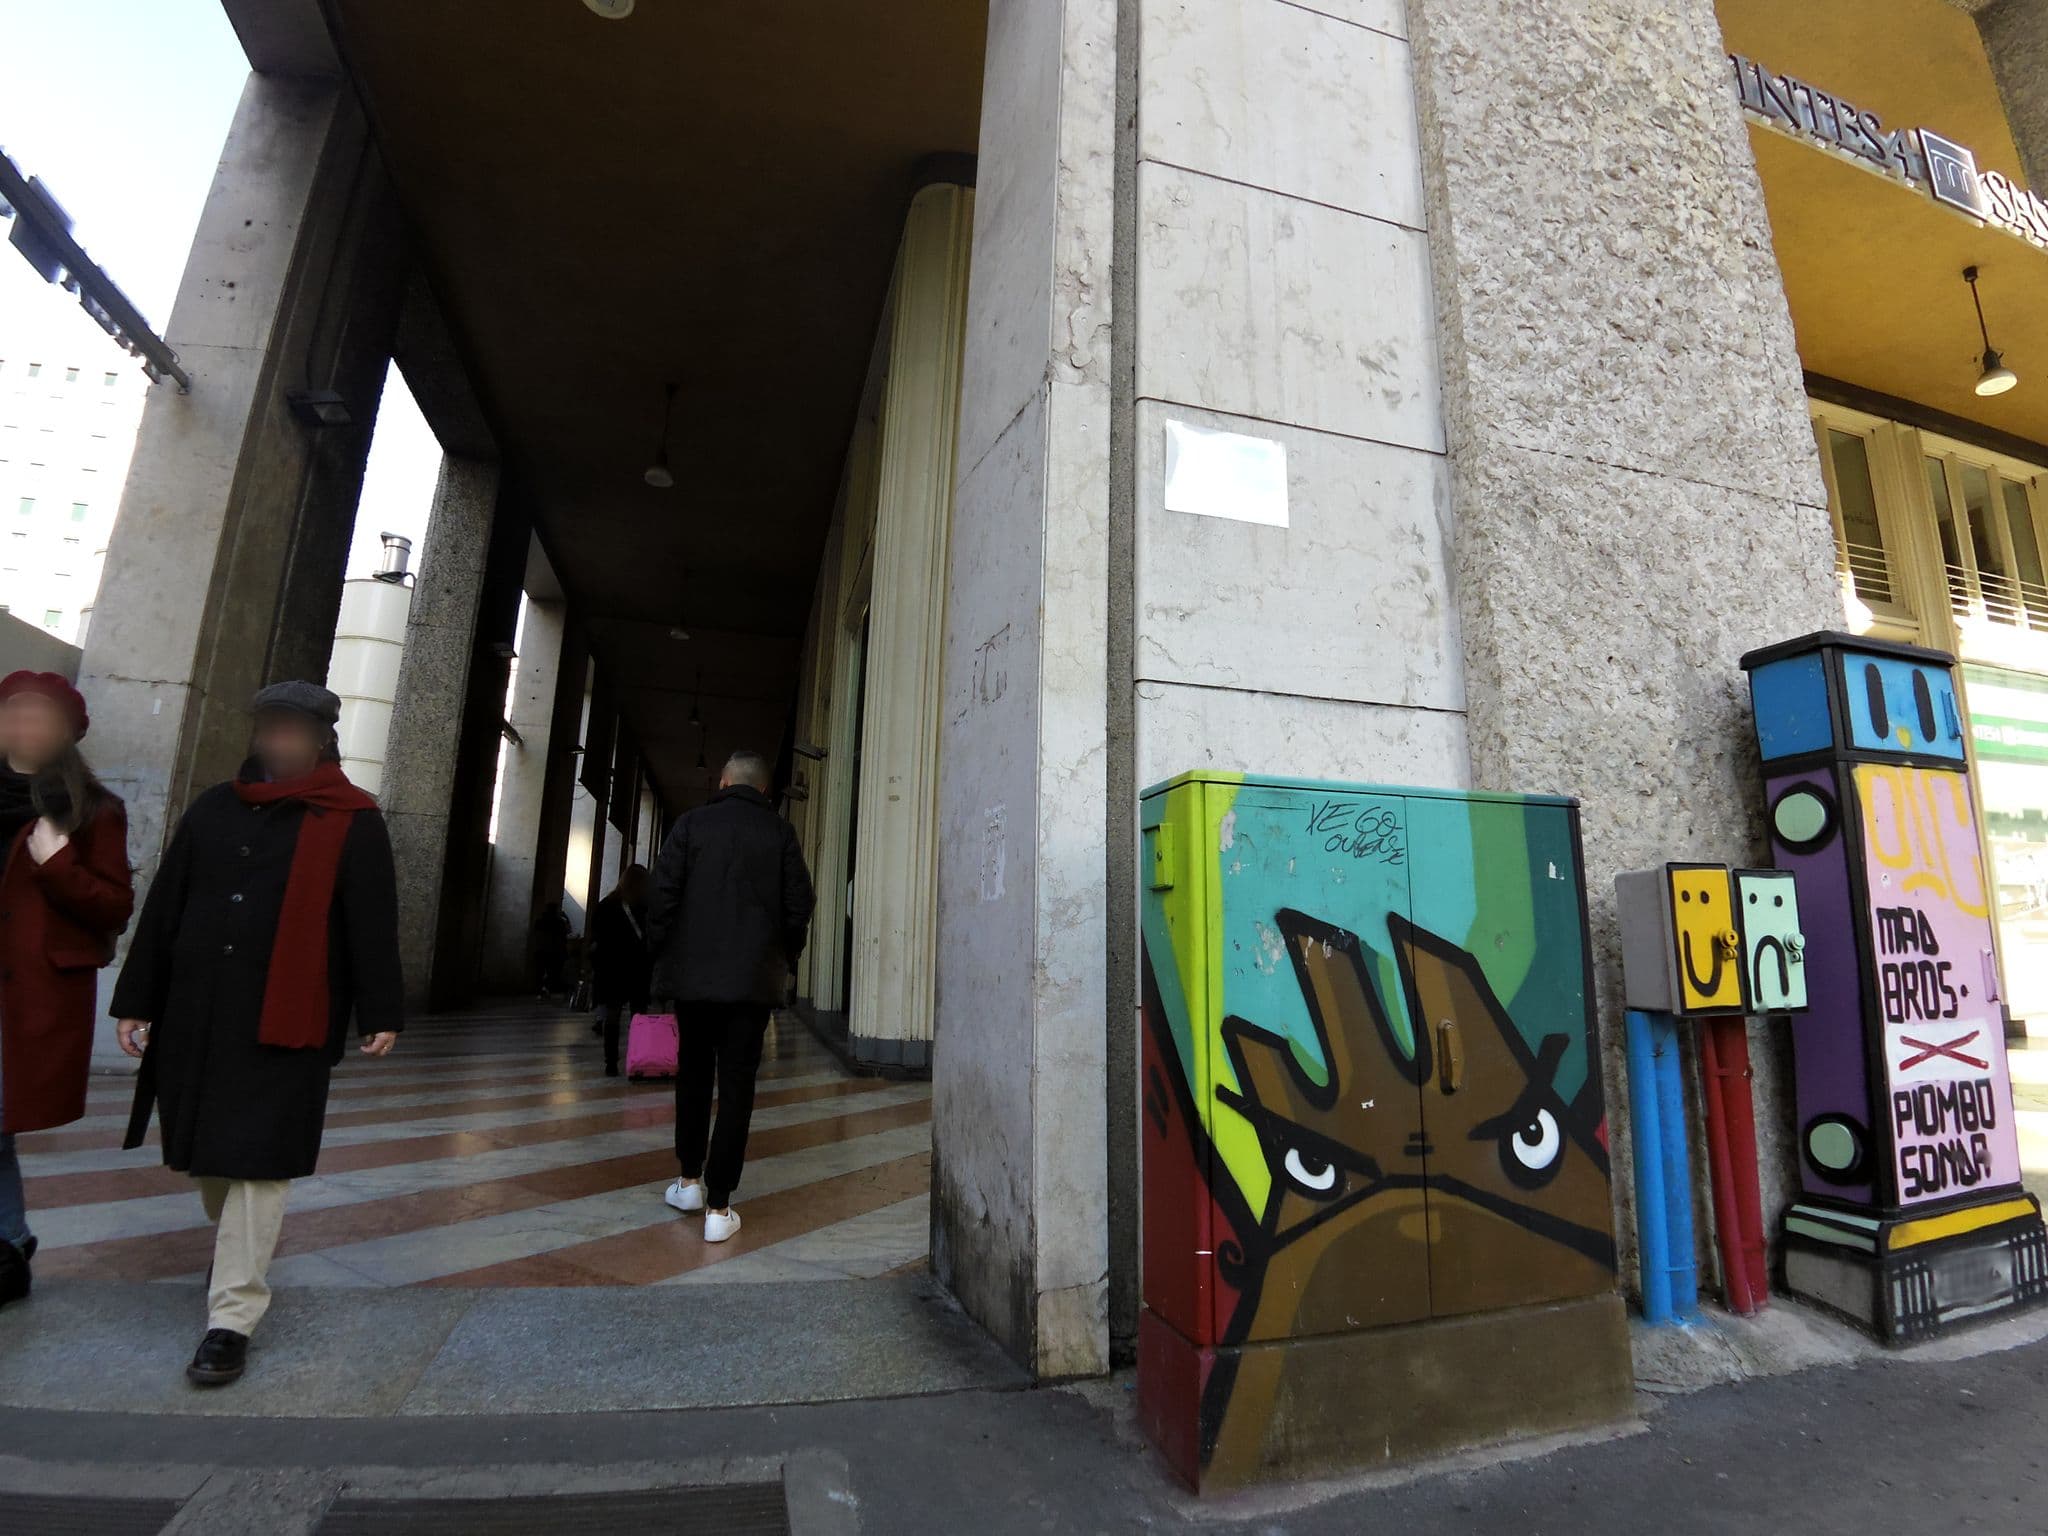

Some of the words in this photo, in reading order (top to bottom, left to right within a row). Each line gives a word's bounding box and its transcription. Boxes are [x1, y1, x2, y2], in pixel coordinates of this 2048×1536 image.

[1728, 53, 1921, 182] INTESA
[1876, 905, 1940, 956] MAD
[1893, 1079, 1996, 1139] PIOMBO
